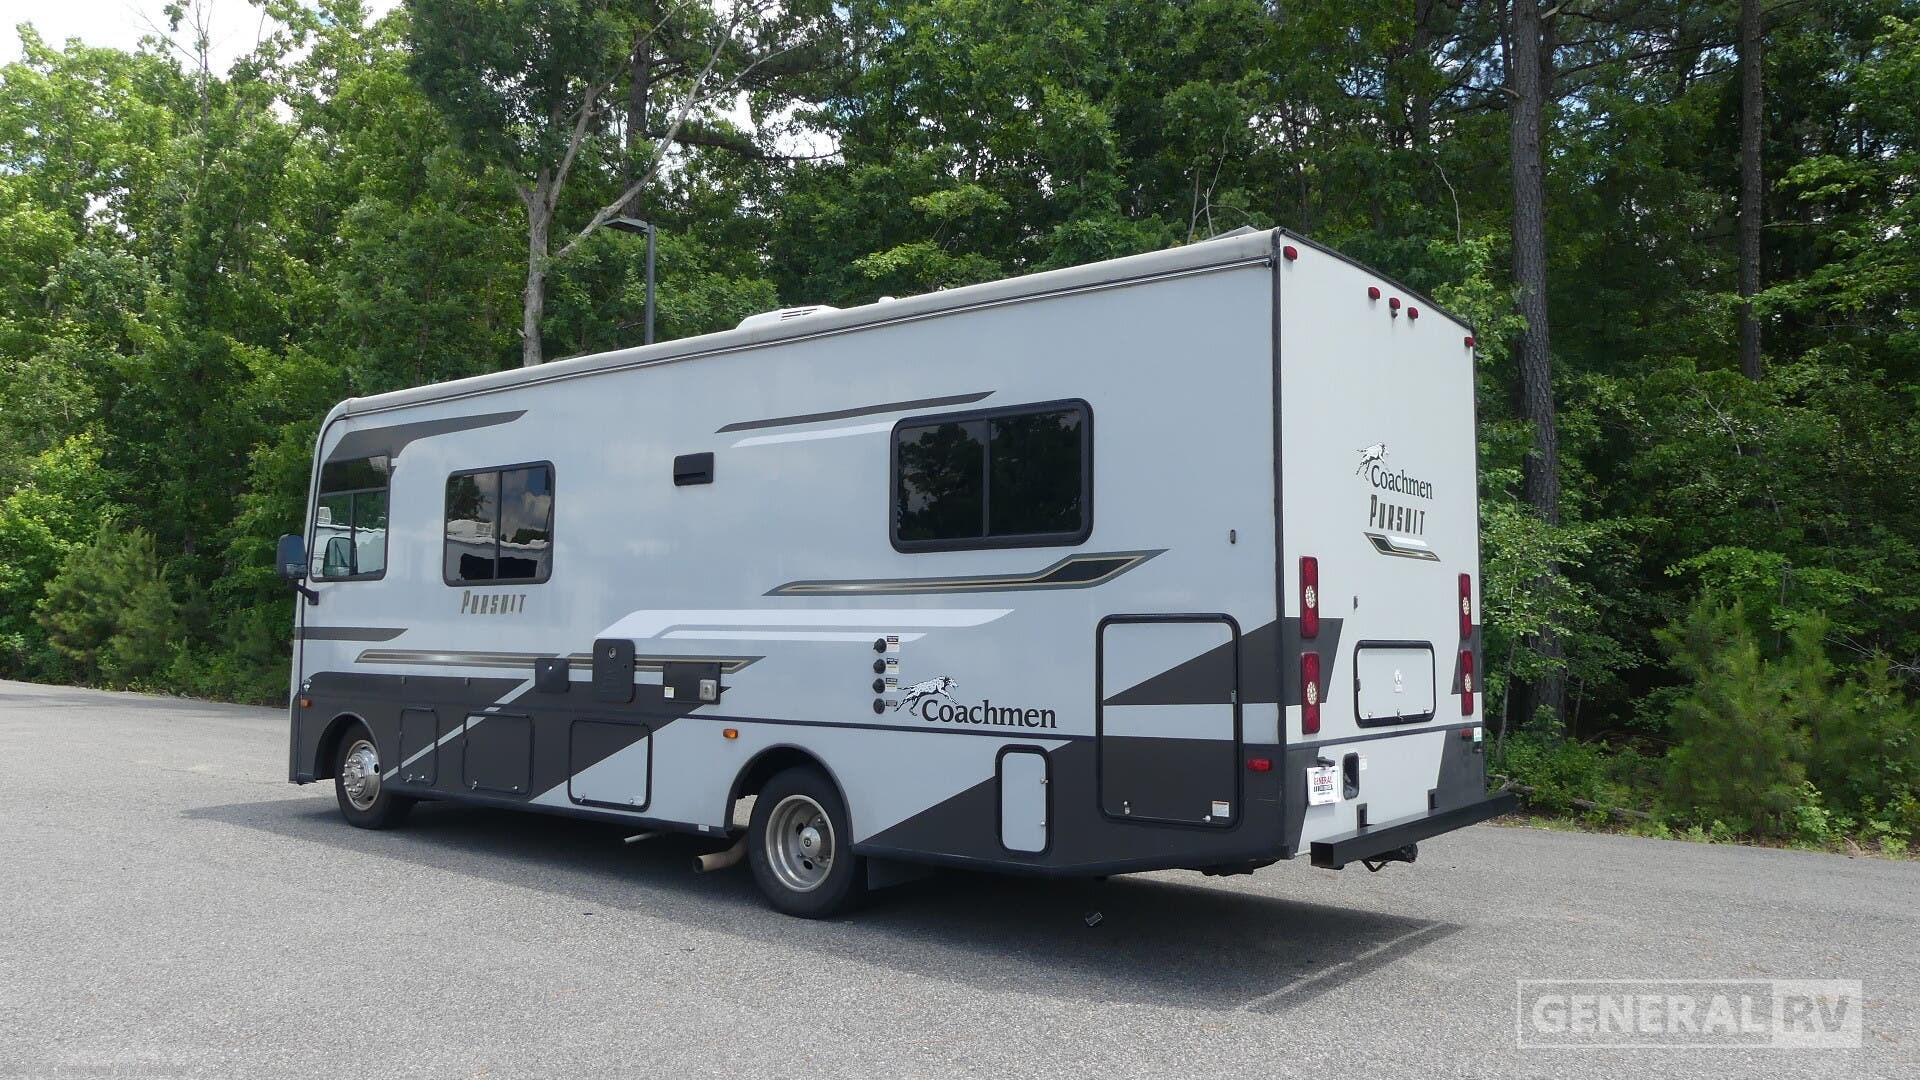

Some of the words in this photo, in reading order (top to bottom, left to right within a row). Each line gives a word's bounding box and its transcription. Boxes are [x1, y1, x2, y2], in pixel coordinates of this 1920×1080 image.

[1371, 465, 1433, 499] Coachmen
[1369, 494, 1426, 535] PURSUIT
[922, 700, 1057, 728] Coachmen
